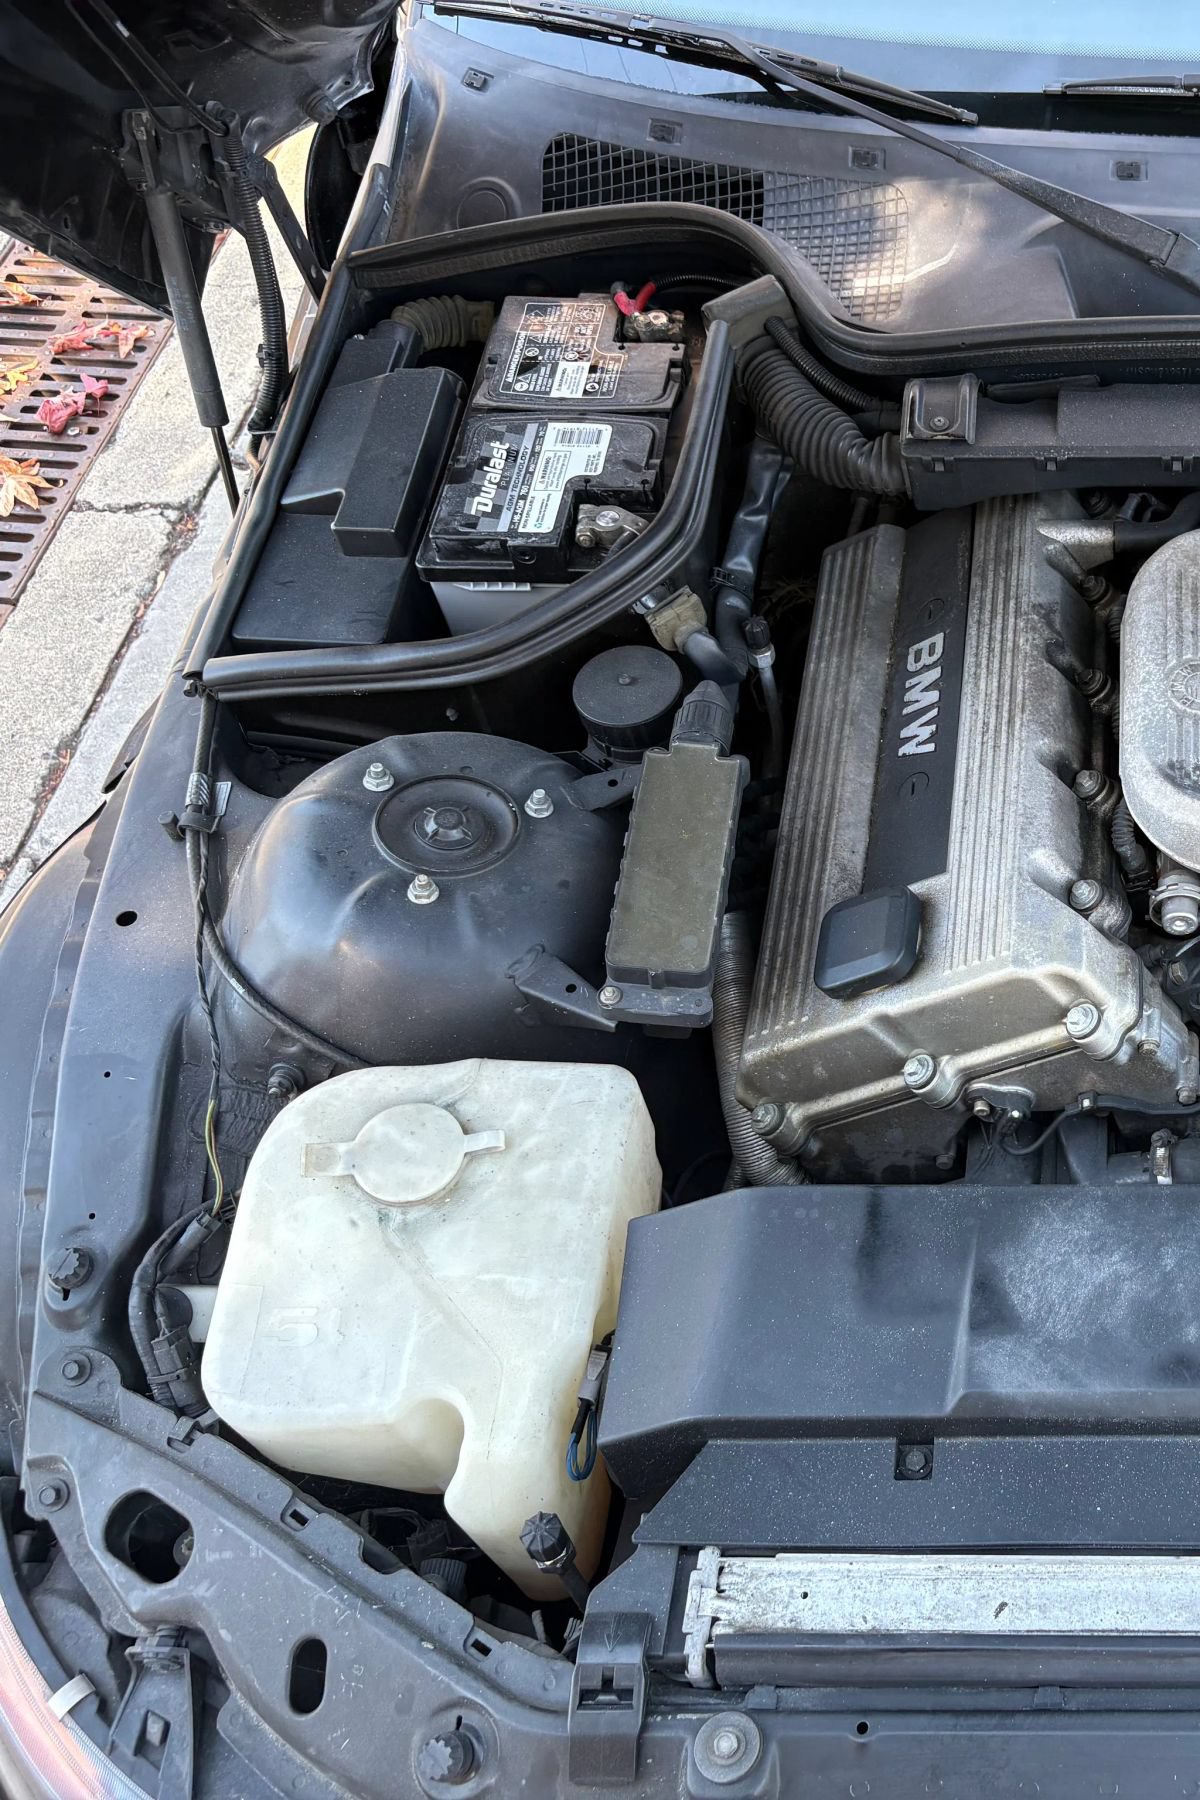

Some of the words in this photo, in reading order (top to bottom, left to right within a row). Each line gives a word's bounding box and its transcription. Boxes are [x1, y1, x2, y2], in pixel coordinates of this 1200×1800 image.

[470, 441, 510, 516] Duralast
[505, 493, 516, 512] AGM
[513, 446, 530, 493] TECHNOLOGY
[897, 631, 945, 758] BMW
